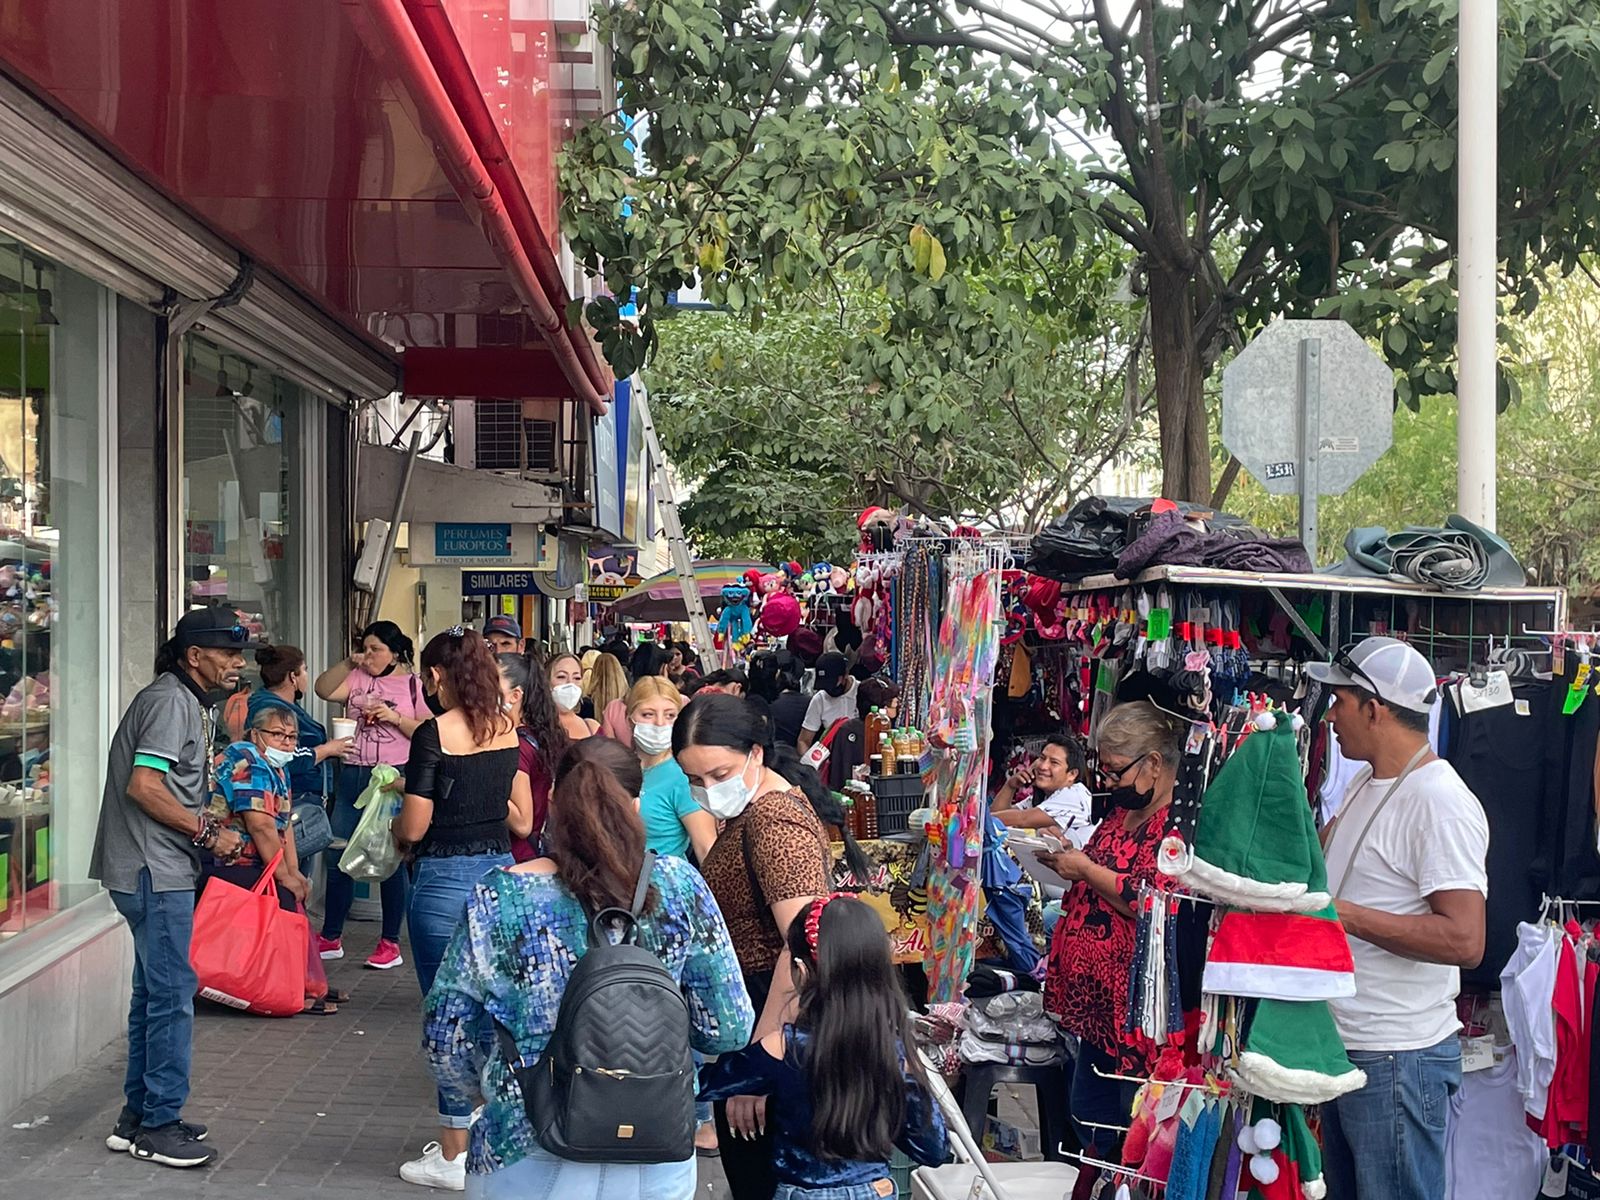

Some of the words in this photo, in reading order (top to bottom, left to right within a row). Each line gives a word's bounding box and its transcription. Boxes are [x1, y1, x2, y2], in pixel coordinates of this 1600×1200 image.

[443, 528, 504, 540] PERFUMES
[443, 541, 504, 552] EUROPEOS
[470, 573, 529, 589] SIMILARES
